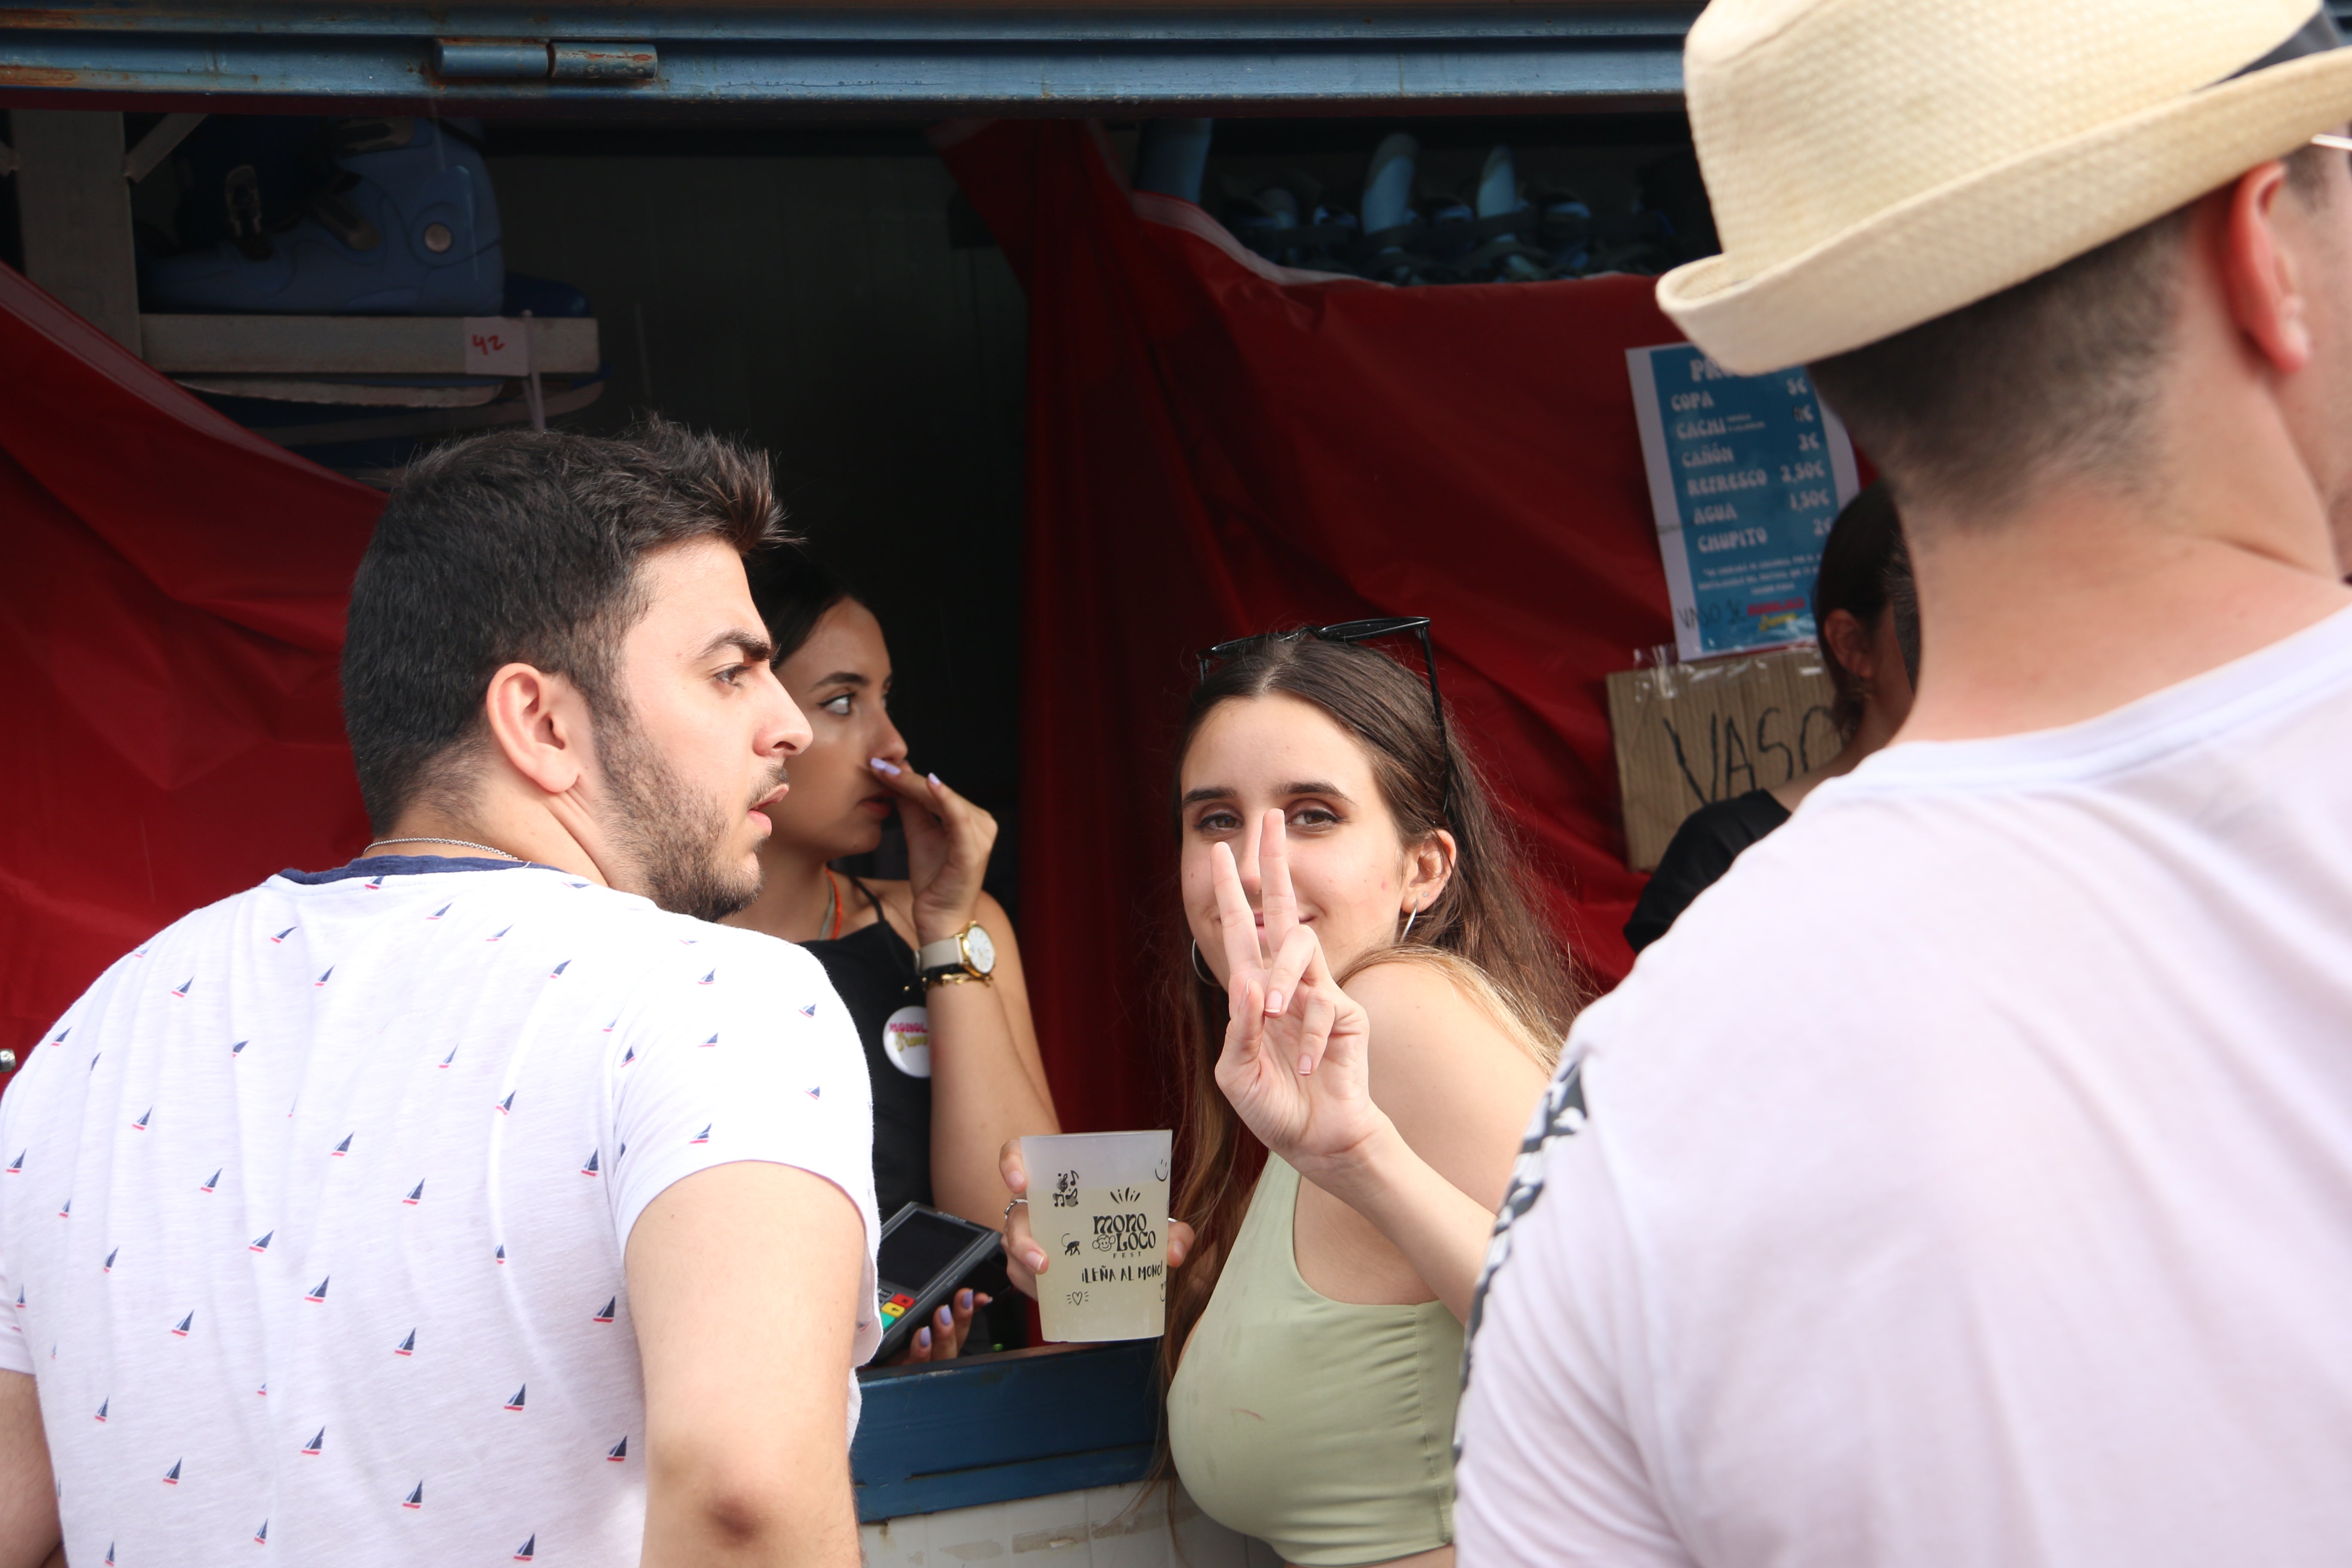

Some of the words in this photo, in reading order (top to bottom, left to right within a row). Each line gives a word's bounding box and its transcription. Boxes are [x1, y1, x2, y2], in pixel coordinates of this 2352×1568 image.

[473, 334, 506, 355] 42
[1672, 391, 1713, 410] COPA
[1687, 470, 1767, 496] REFRESCO
[1694, 504, 1738, 525] AGUA
[1698, 527, 1768, 552] CHUPITO
[1116, 1230, 1156, 1252] LOCO
[1121, 1265, 1134, 1282] AL
